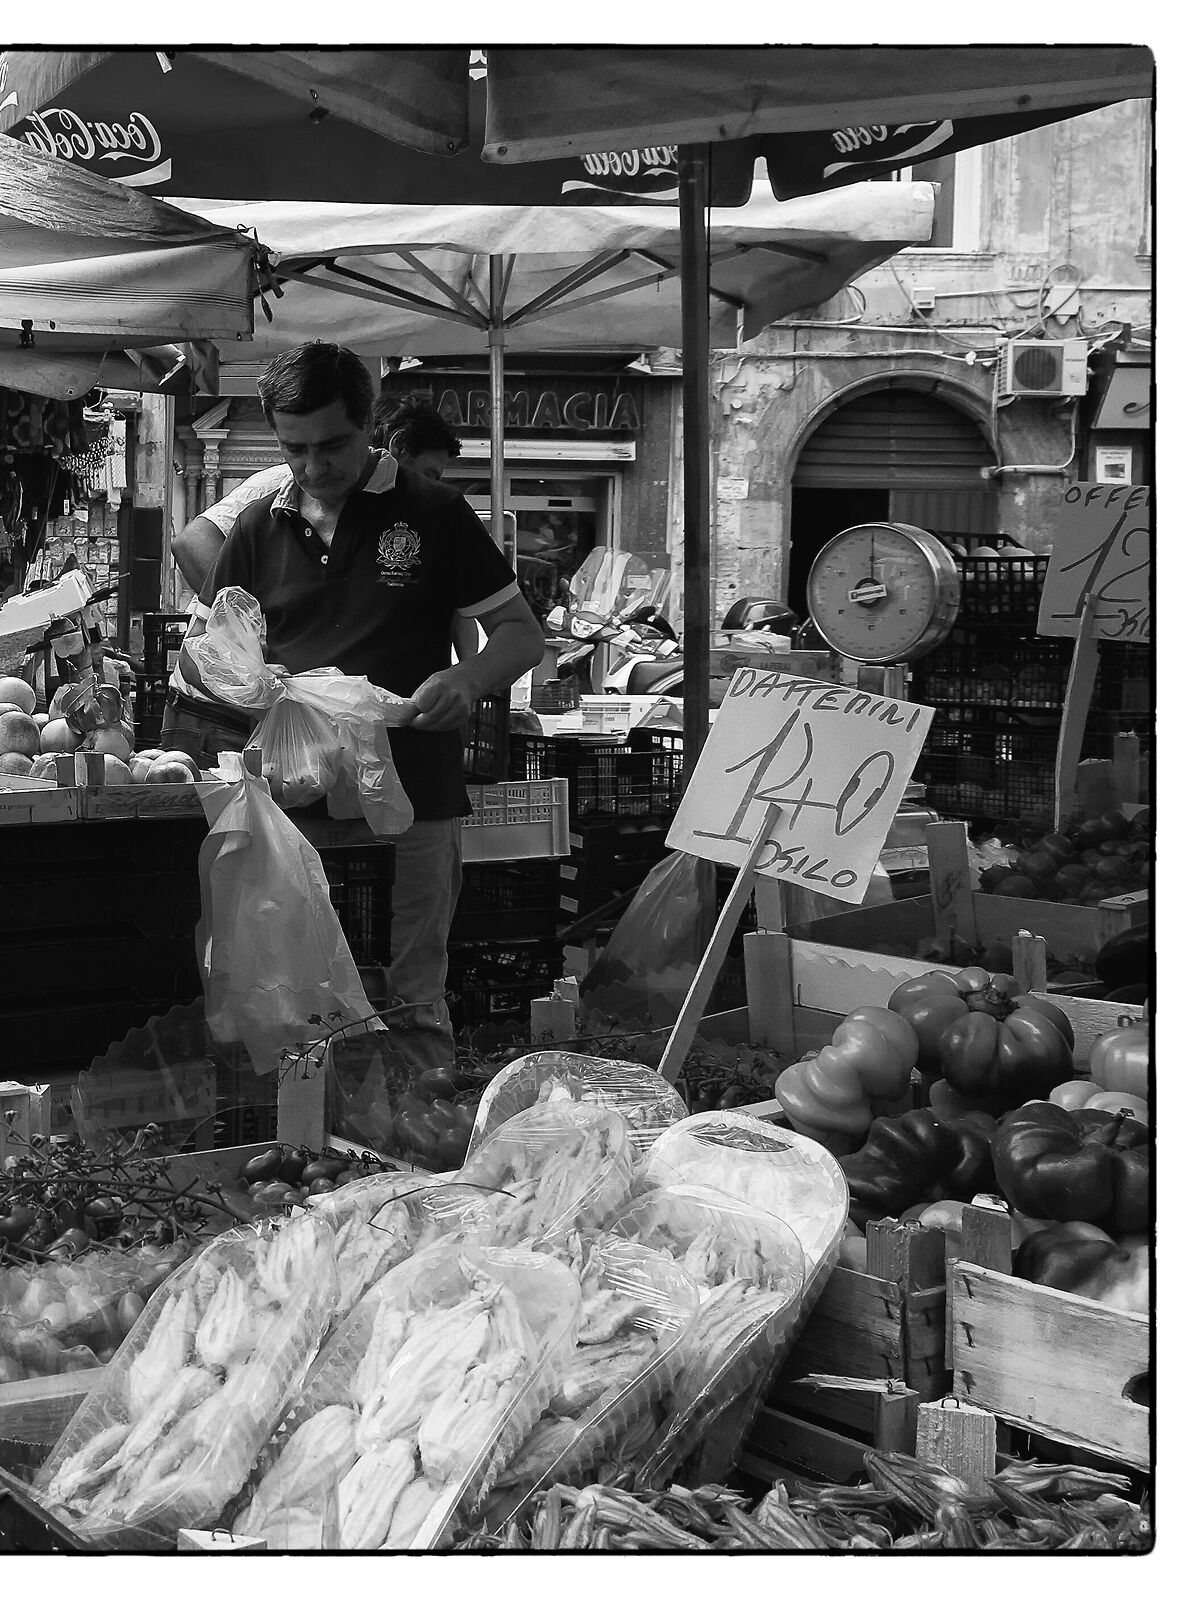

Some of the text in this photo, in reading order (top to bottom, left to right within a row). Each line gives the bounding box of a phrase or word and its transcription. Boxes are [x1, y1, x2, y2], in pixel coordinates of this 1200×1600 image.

[409, 388, 641, 431] ARMACIA
[1064, 485, 1150, 511] OFFE
[729, 669, 921, 733] DATTERINI
